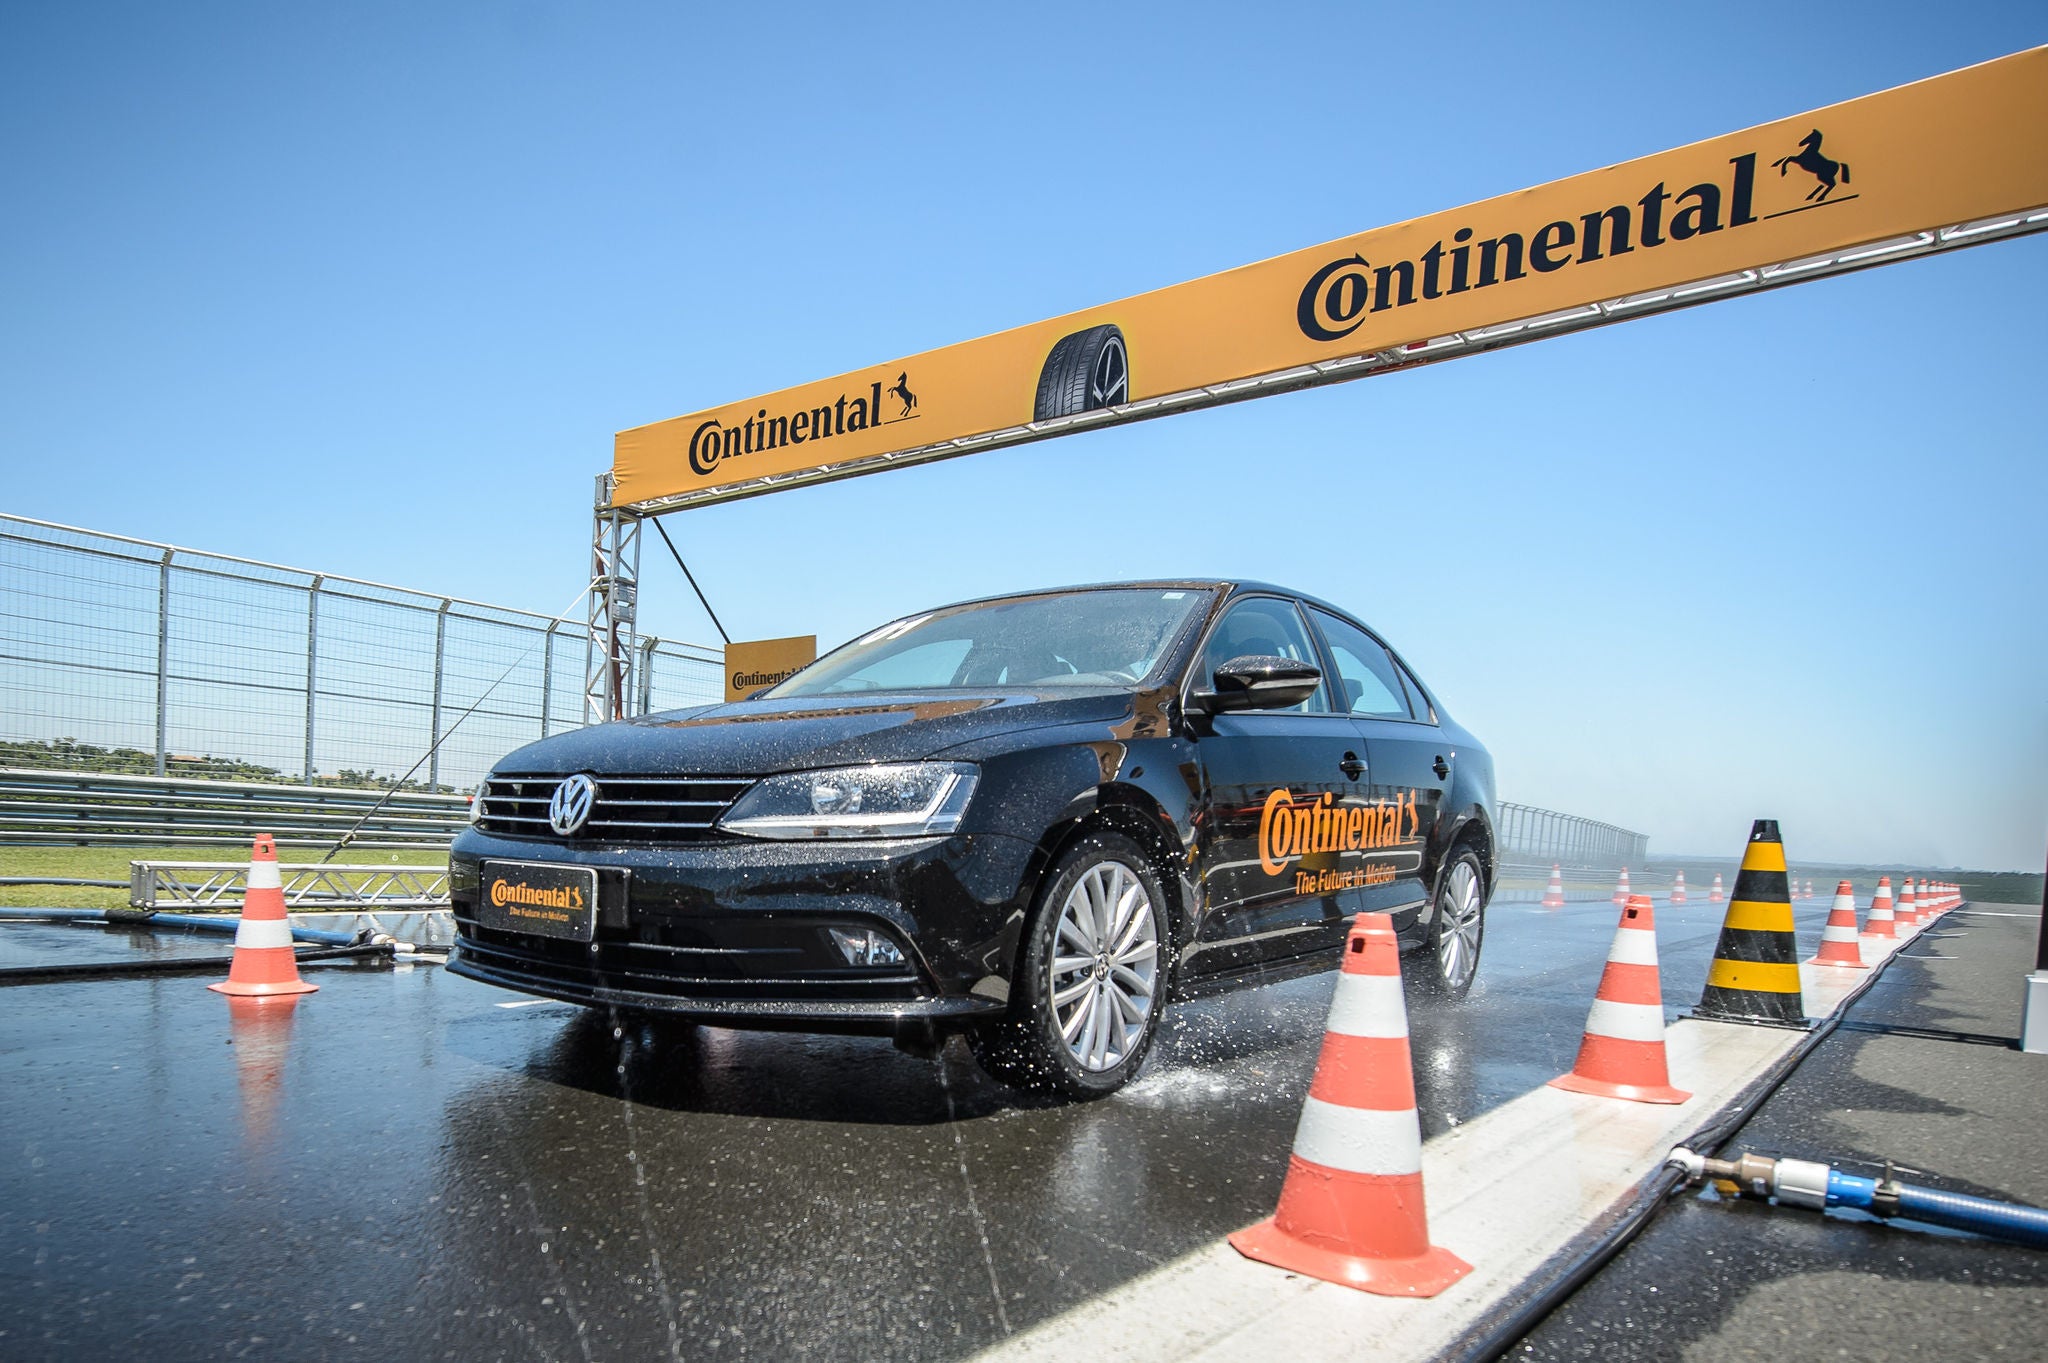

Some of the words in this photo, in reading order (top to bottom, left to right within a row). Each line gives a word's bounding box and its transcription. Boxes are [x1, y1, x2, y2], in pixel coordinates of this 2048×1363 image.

[1297, 152, 1758, 342] Continental
[689, 381, 882, 476] Continental
[732, 668, 796, 690] Continent
[1258, 787, 1404, 877] Continental
[491, 878, 571, 908] Continental
[1295, 871, 1316, 895] The
[1318, 868, 1353, 892] Future
[1354, 866, 1364, 887] in
[1365, 862, 1396, 885] Motion
